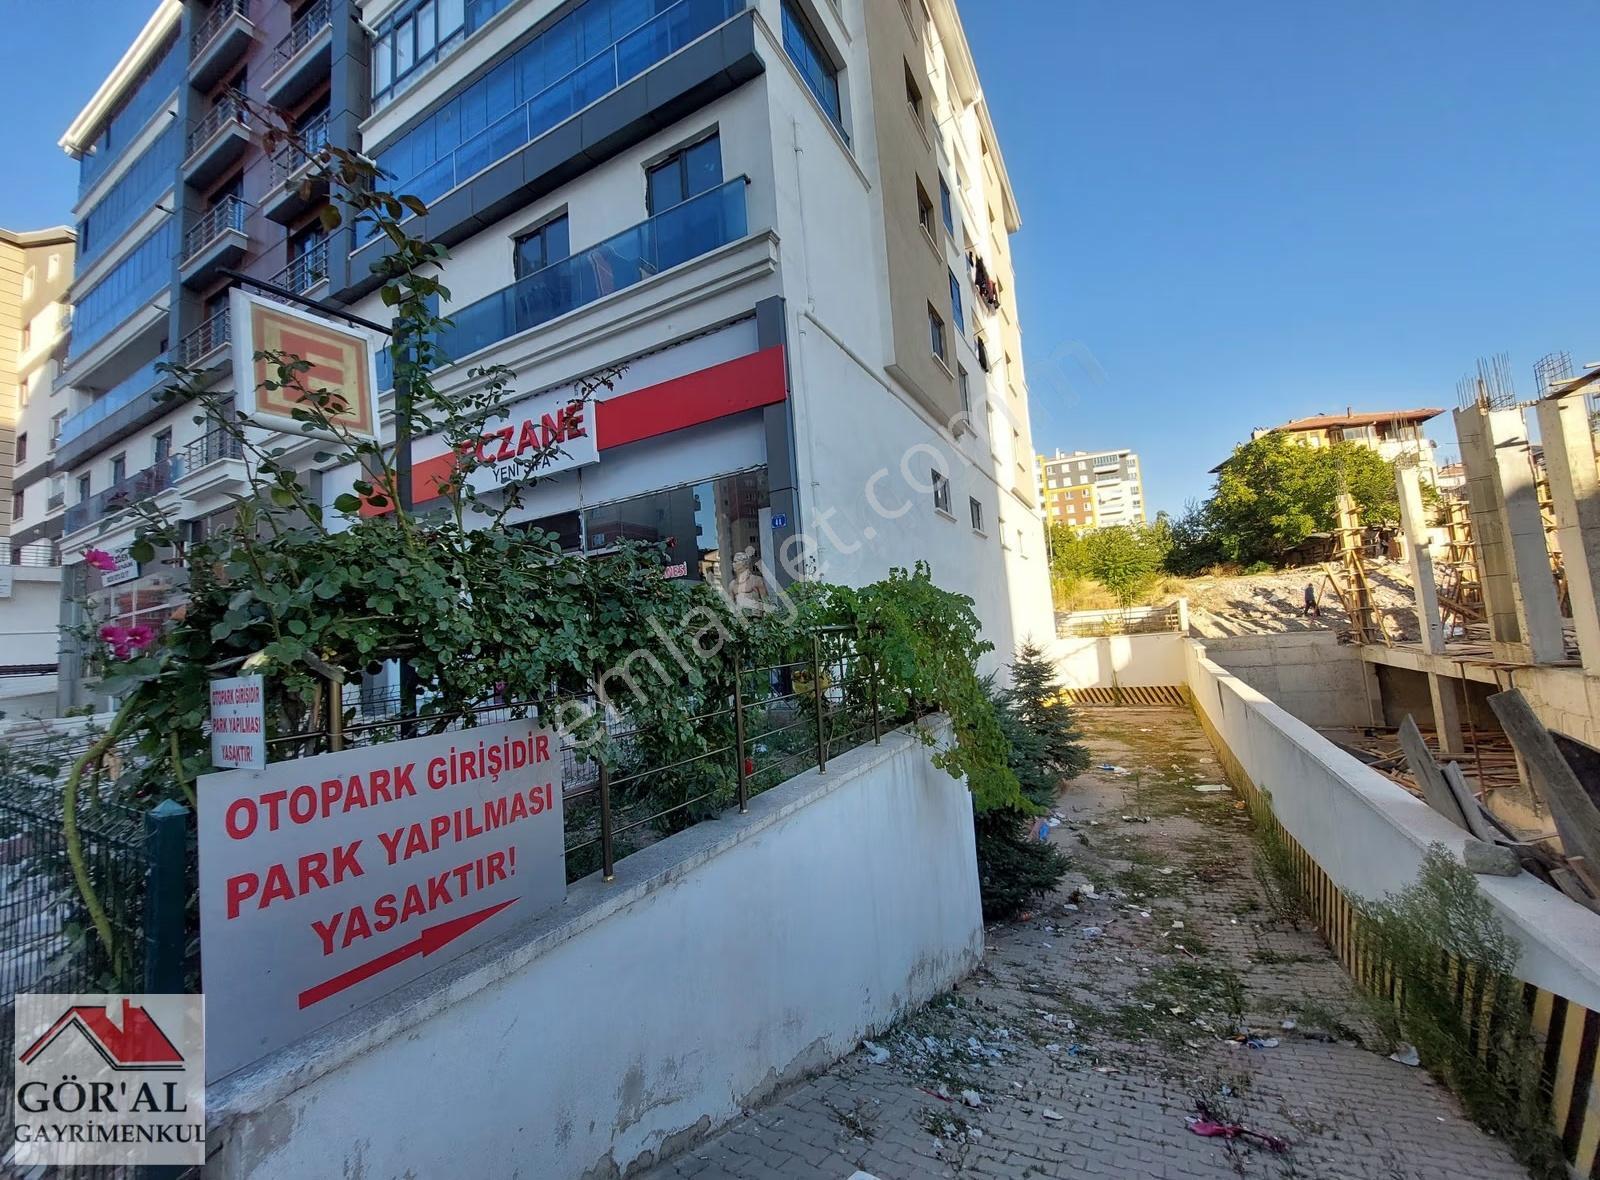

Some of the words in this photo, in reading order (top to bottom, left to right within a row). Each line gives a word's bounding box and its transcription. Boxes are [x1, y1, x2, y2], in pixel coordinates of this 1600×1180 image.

[280, 329, 345, 413] E
[212, 688, 235, 706] OTOPARK
[212, 717, 228, 734] PARK
[228, 716, 261, 734] YAPILMASI
[221, 744, 253, 762] YASAKTIR!
[225, 762, 417, 840] OTOPARK
[427, 730, 551, 790] GİRİŞİDİR
[226, 839, 365, 920] PARK
[377, 783, 553, 866] YAPILMASI
[311, 846, 517, 956] YASAKTIR!
